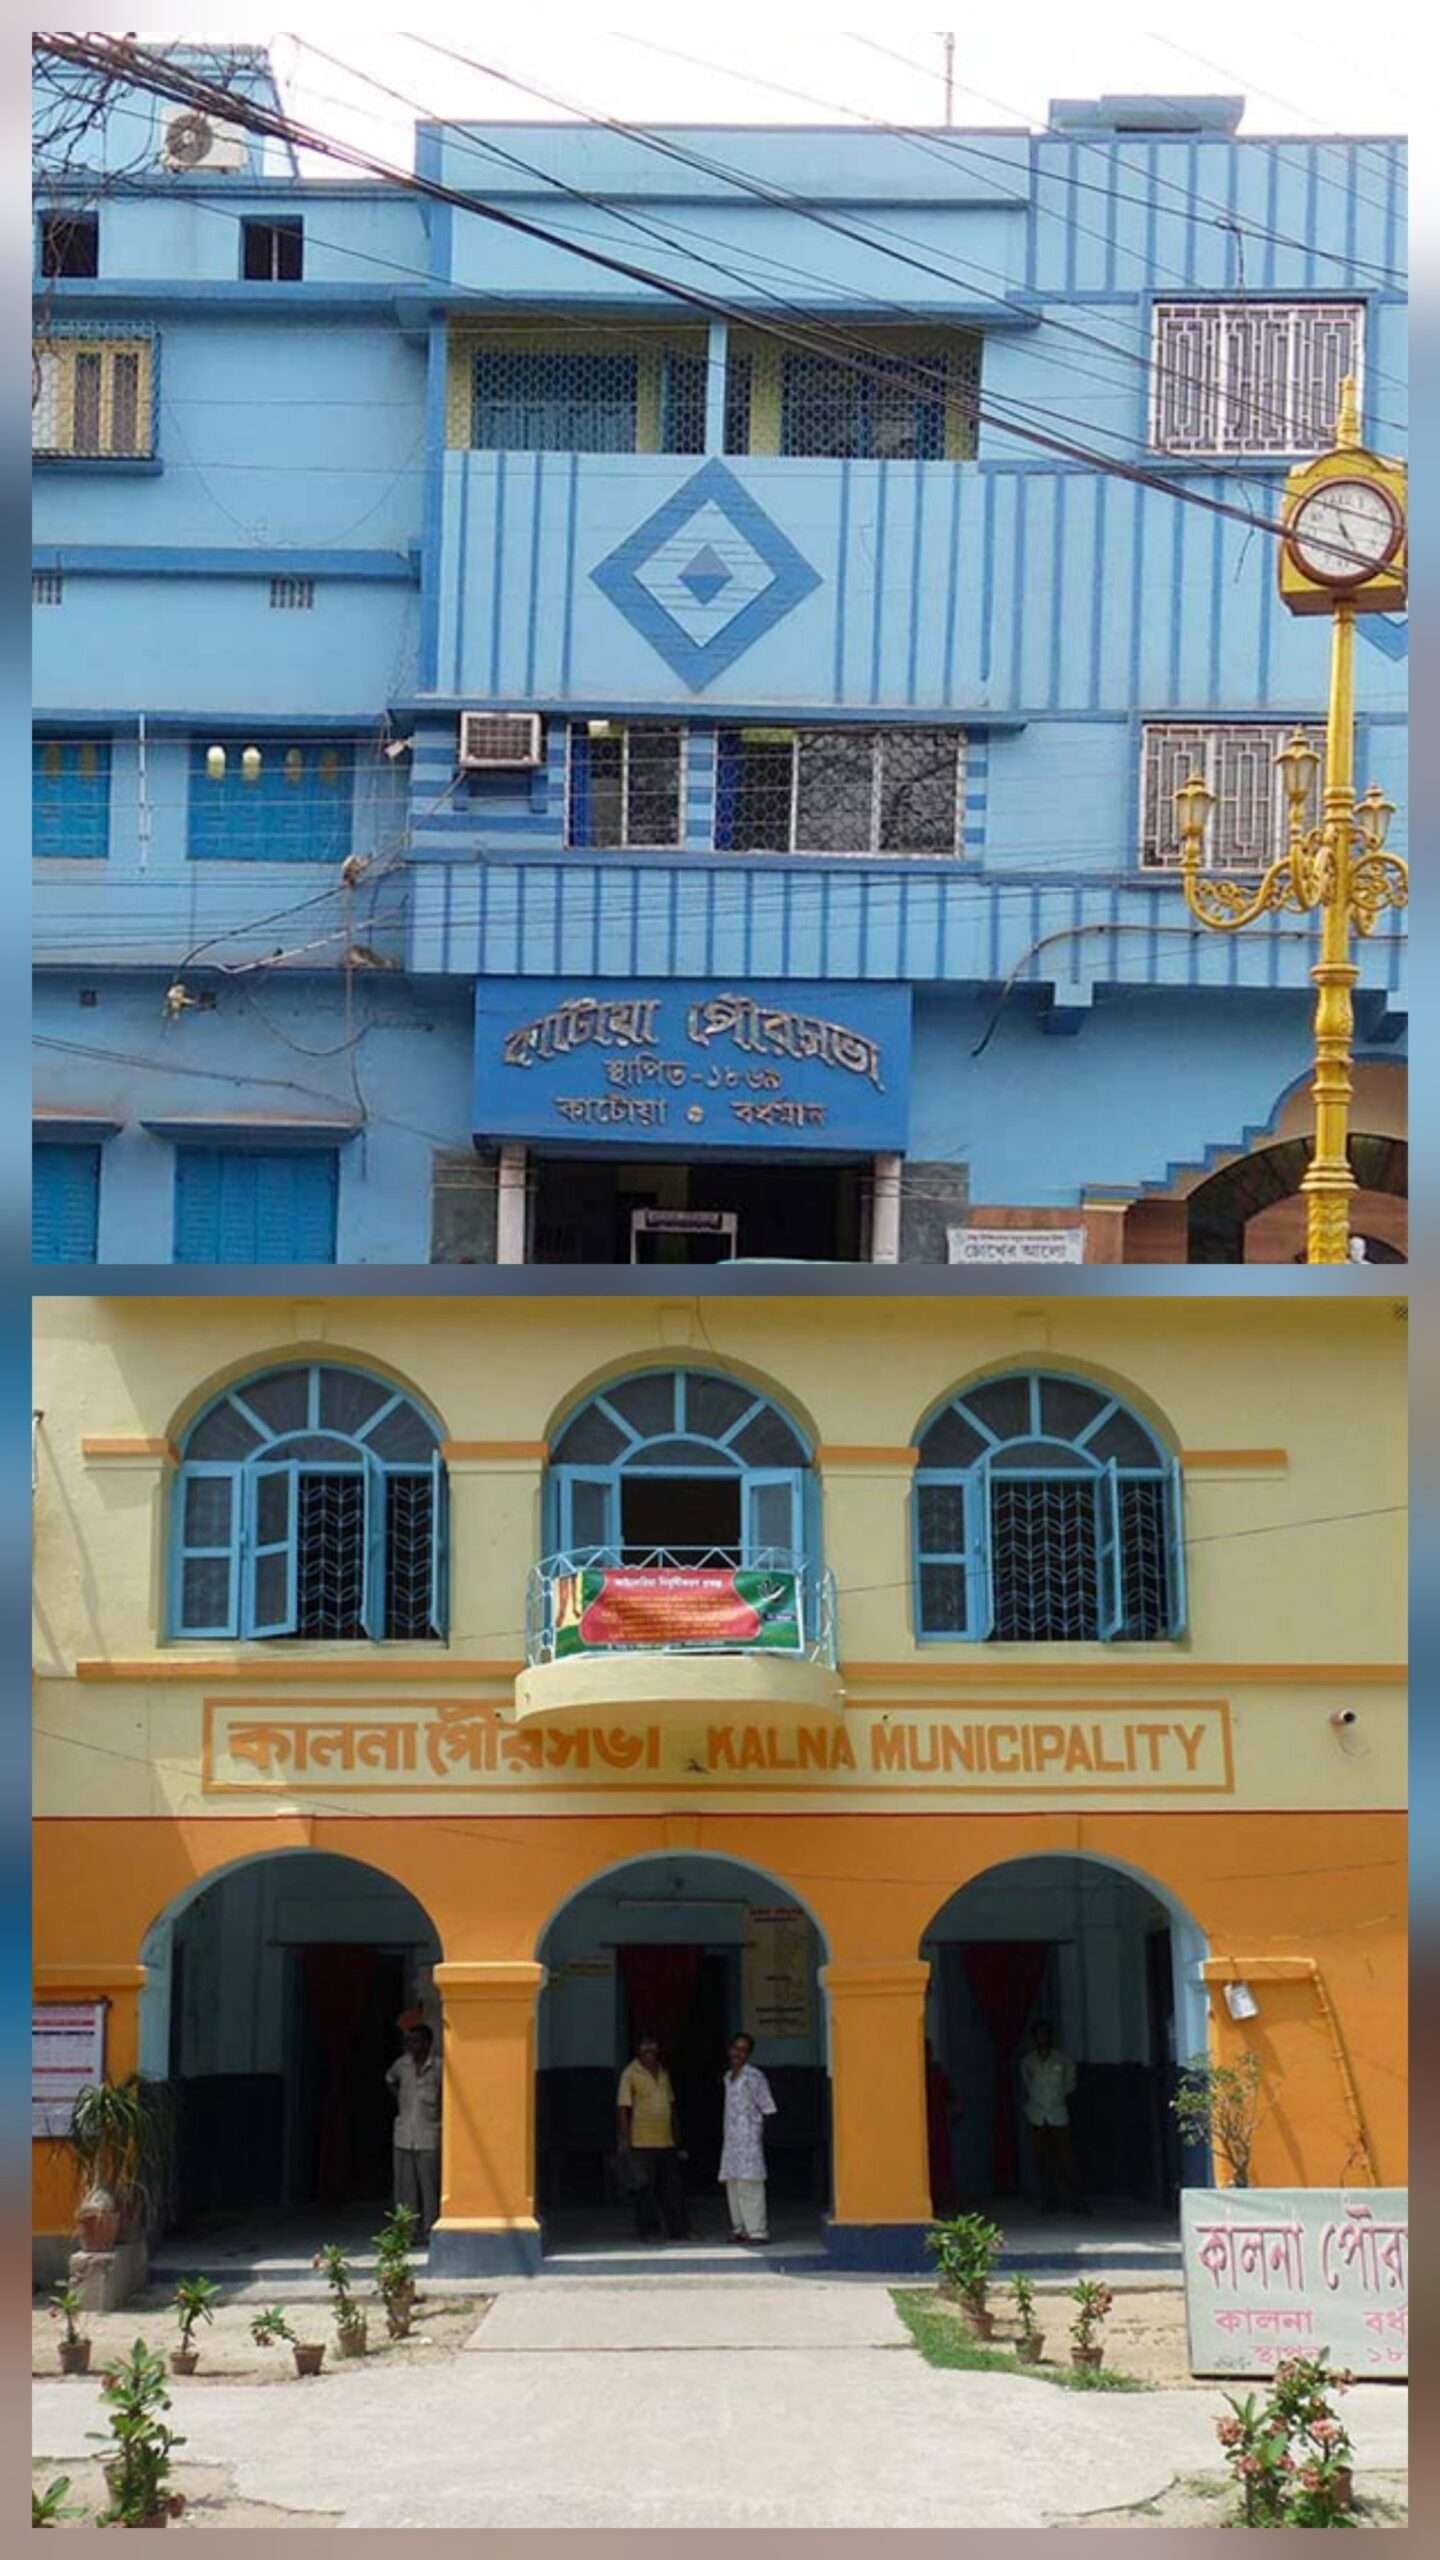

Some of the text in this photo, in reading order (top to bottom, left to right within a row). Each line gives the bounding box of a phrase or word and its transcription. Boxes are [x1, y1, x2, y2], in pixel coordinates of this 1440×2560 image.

[504, 992, 887, 1094] কাটোয়া পৌরসভা
[555, 1096, 667, 1126] কাটোয়া
[226, 1705, 661, 1777] কালনা পৌরসভা
[706, 1723, 1207, 1774] KALNA MUNICIPALITY
[1196, 2205, 1408, 2293] কালনা পৌর
[1213, 2308, 1313, 2335] কালনা
[1366, 2347, 1408, 2363] ১৮
